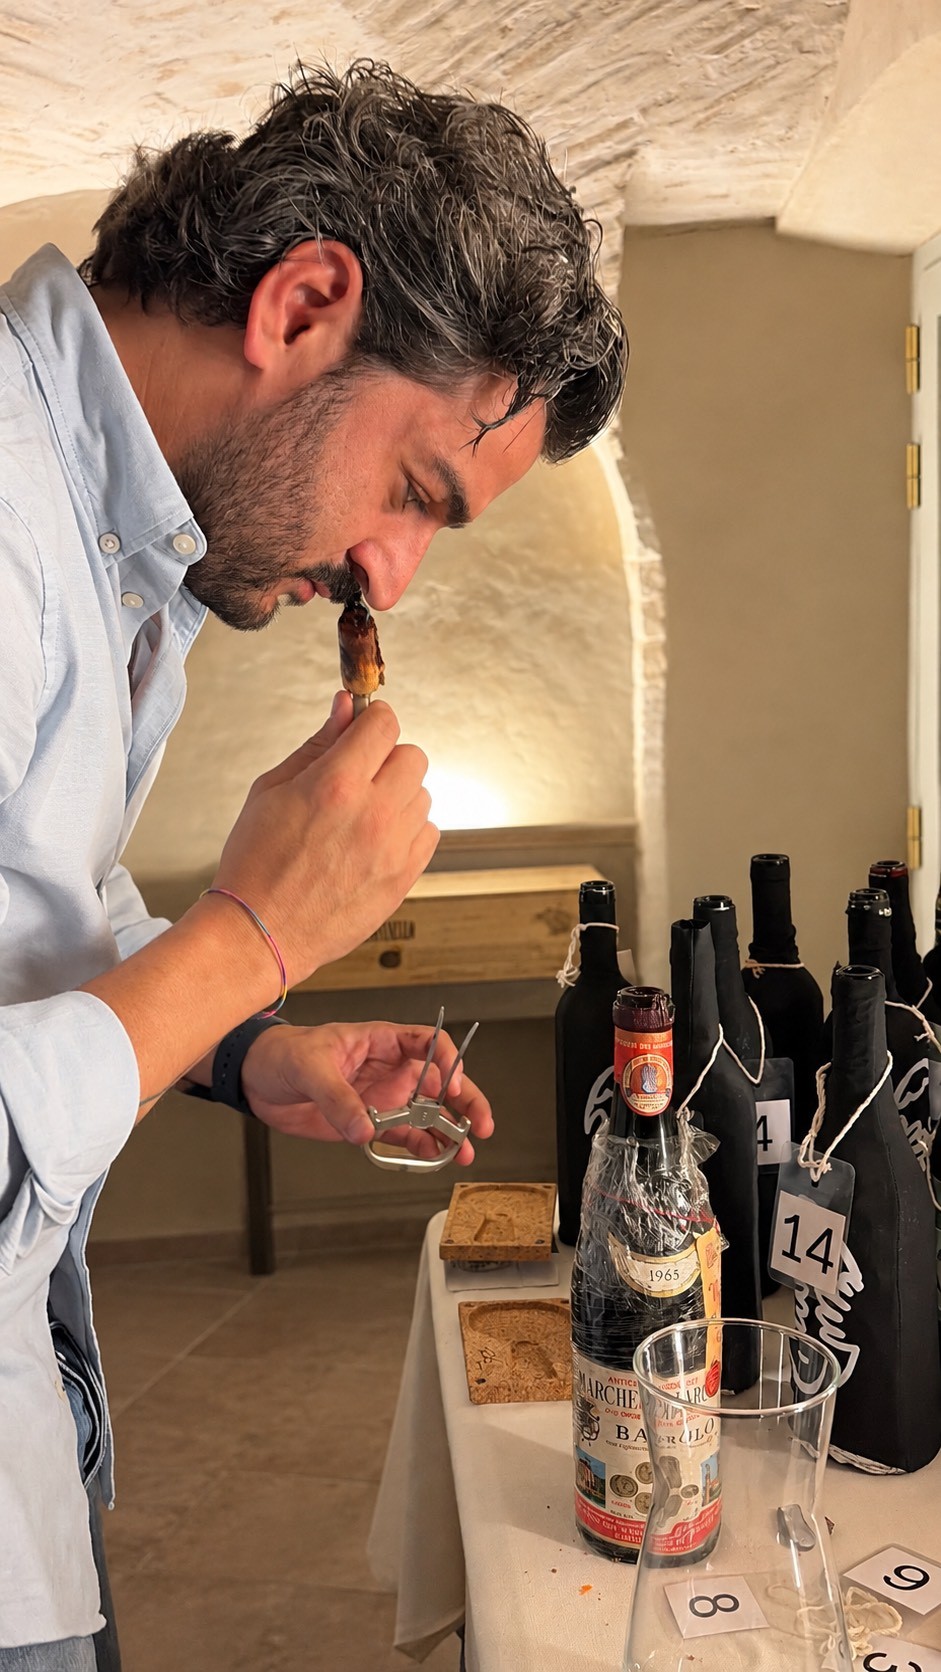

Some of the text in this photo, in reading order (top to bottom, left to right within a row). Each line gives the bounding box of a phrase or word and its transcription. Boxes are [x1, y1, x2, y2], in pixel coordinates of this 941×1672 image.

[781, 1214, 834, 1274] 14
[650, 1268, 680, 1282] 1965
[578, 1370, 640, 1410] MARCHE
[688, 1593, 740, 1618] 8
